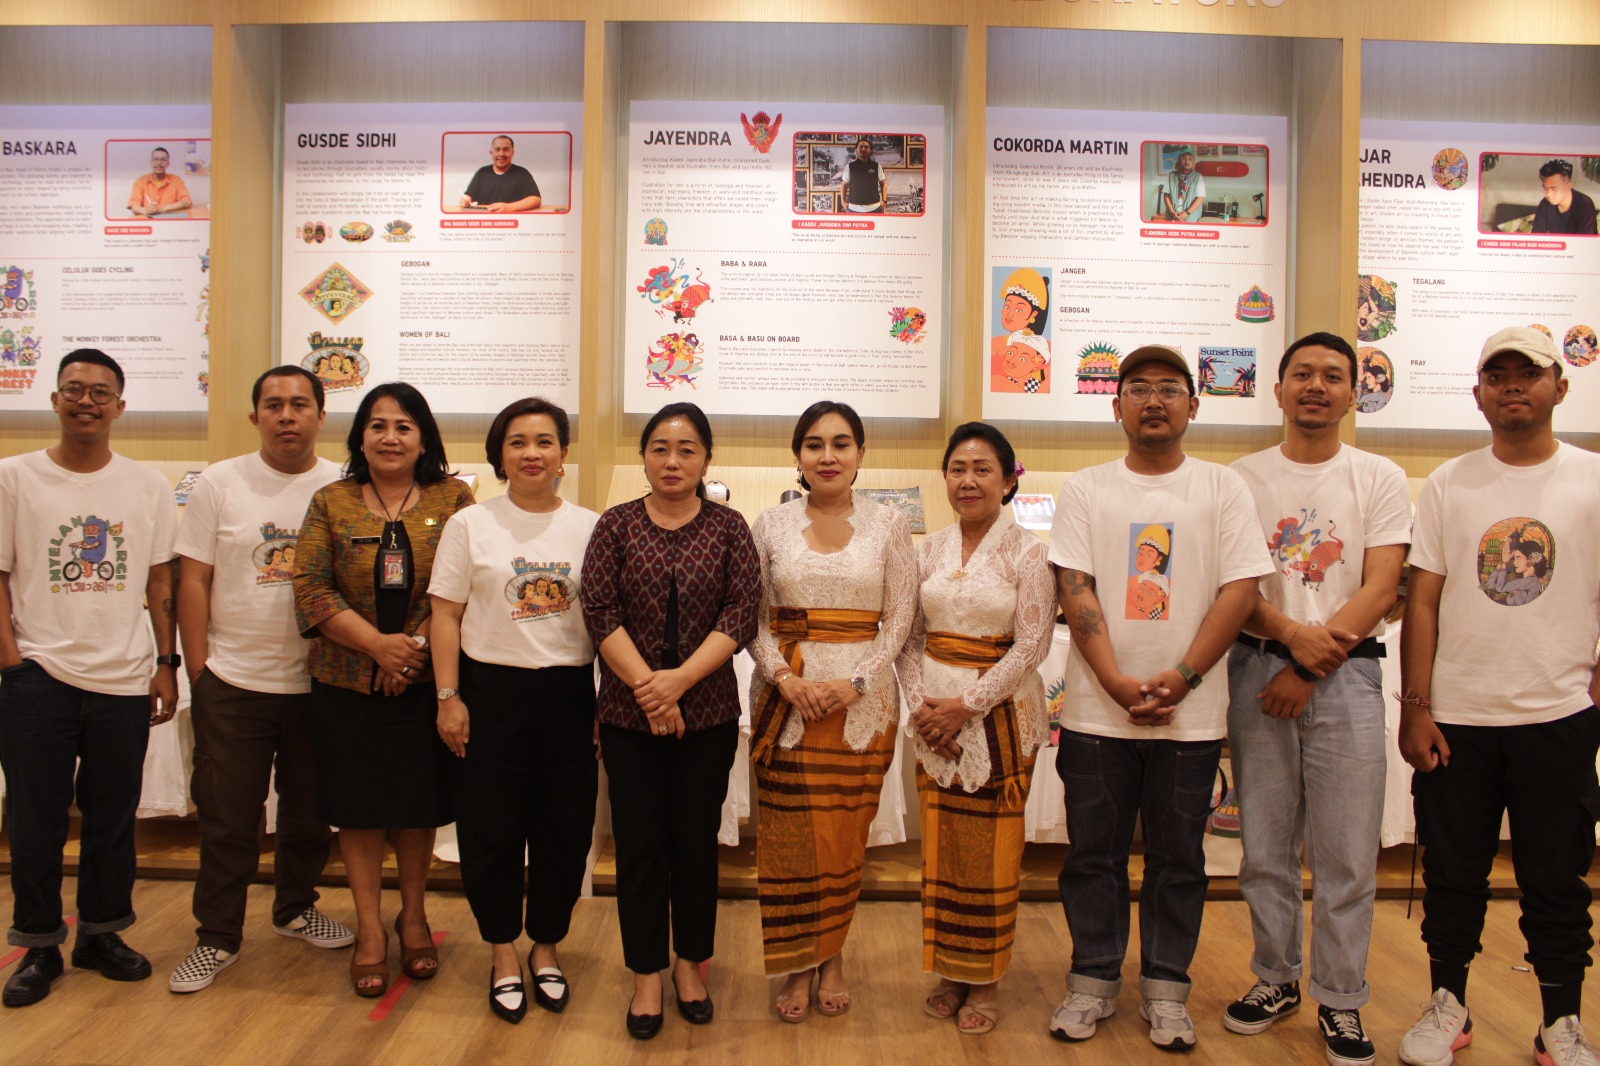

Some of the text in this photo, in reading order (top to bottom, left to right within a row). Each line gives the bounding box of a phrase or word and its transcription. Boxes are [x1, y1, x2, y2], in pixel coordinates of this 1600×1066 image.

[297, 133, 396, 148] GUSDE SIDHI
[644, 130, 732, 146] JAYENDRA
[3, 141, 77, 155] BASKARA
[993, 138, 1128, 155] COKORDA MARTIN
[1359, 173, 1426, 188] HENDRA
[1200, 347, 1255, 357] Sunset Point
